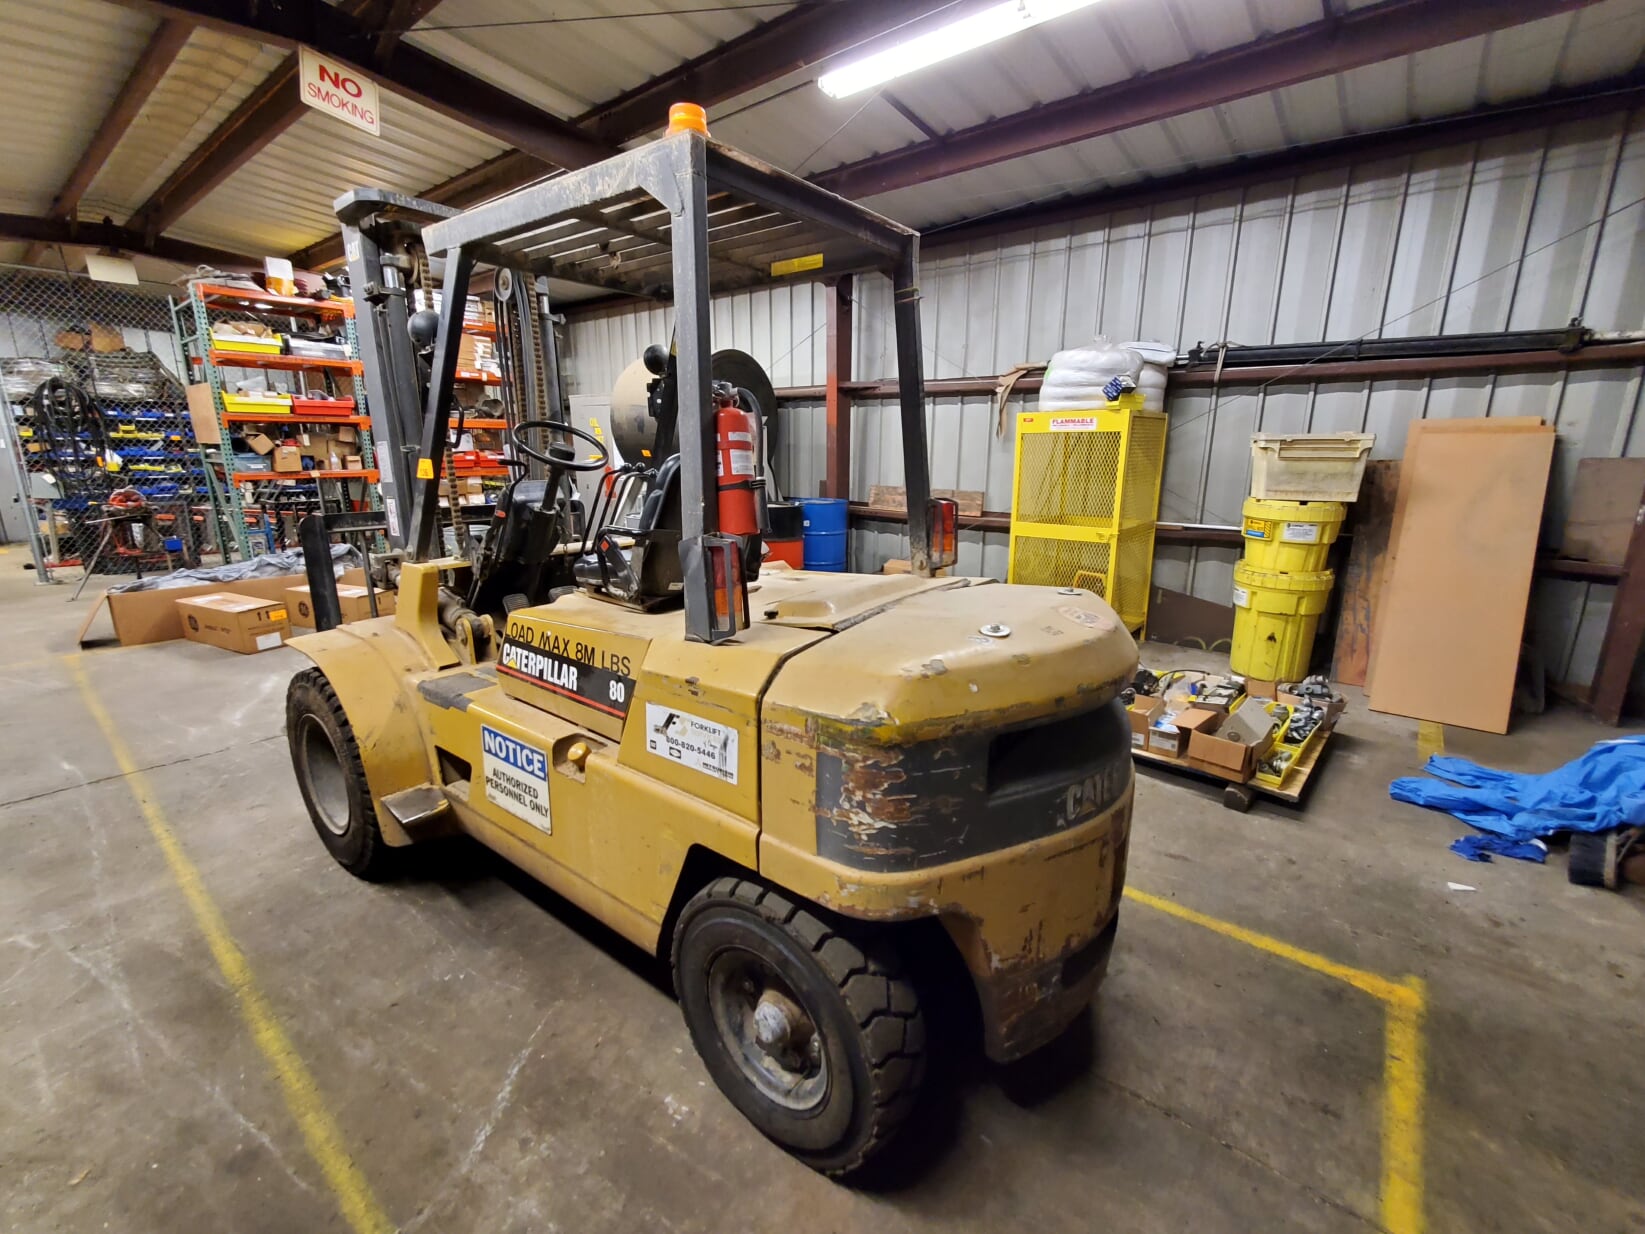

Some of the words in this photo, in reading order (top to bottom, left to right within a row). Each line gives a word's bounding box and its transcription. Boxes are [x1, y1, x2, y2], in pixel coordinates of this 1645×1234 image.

[319, 64, 362, 98] NO
[308, 82, 374, 124] SMOKING
[503, 643, 578, 691] CATERPILLAR
[609, 680, 625, 702] 80
[540, 631, 570, 658] MAX
[575, 642, 595, 666] 8M
[601, 650, 631, 676] LBS
[690, 721, 721, 735] FORKLIFT
[484, 730, 545, 779] NOTICE
[486, 776, 527, 807] PERSONNEL
[529, 800, 549, 818] ONLY
[493, 768, 538, 799] AUTHORIZED
